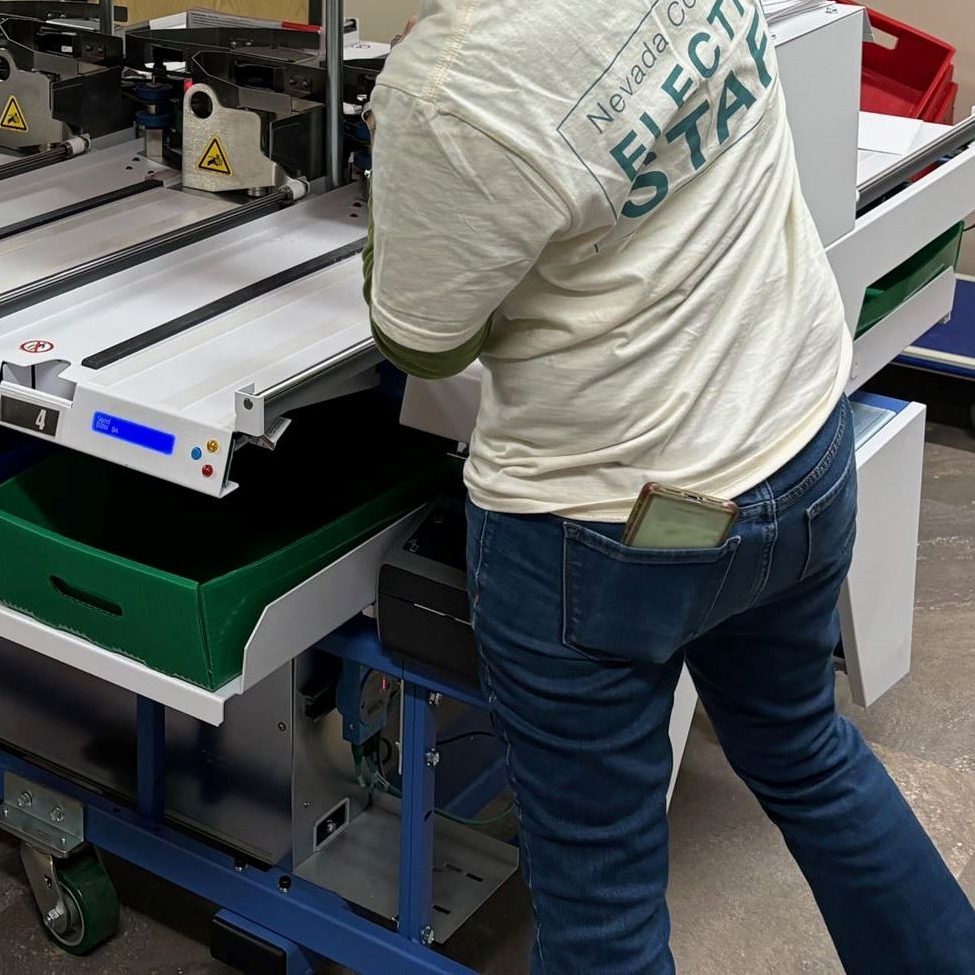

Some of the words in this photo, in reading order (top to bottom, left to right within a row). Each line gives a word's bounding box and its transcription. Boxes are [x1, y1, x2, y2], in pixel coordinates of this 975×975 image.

[586, 31, 669, 134] Nevada
[621, 6, 773, 218] STAF
[35, 409, 47, 430] 4
